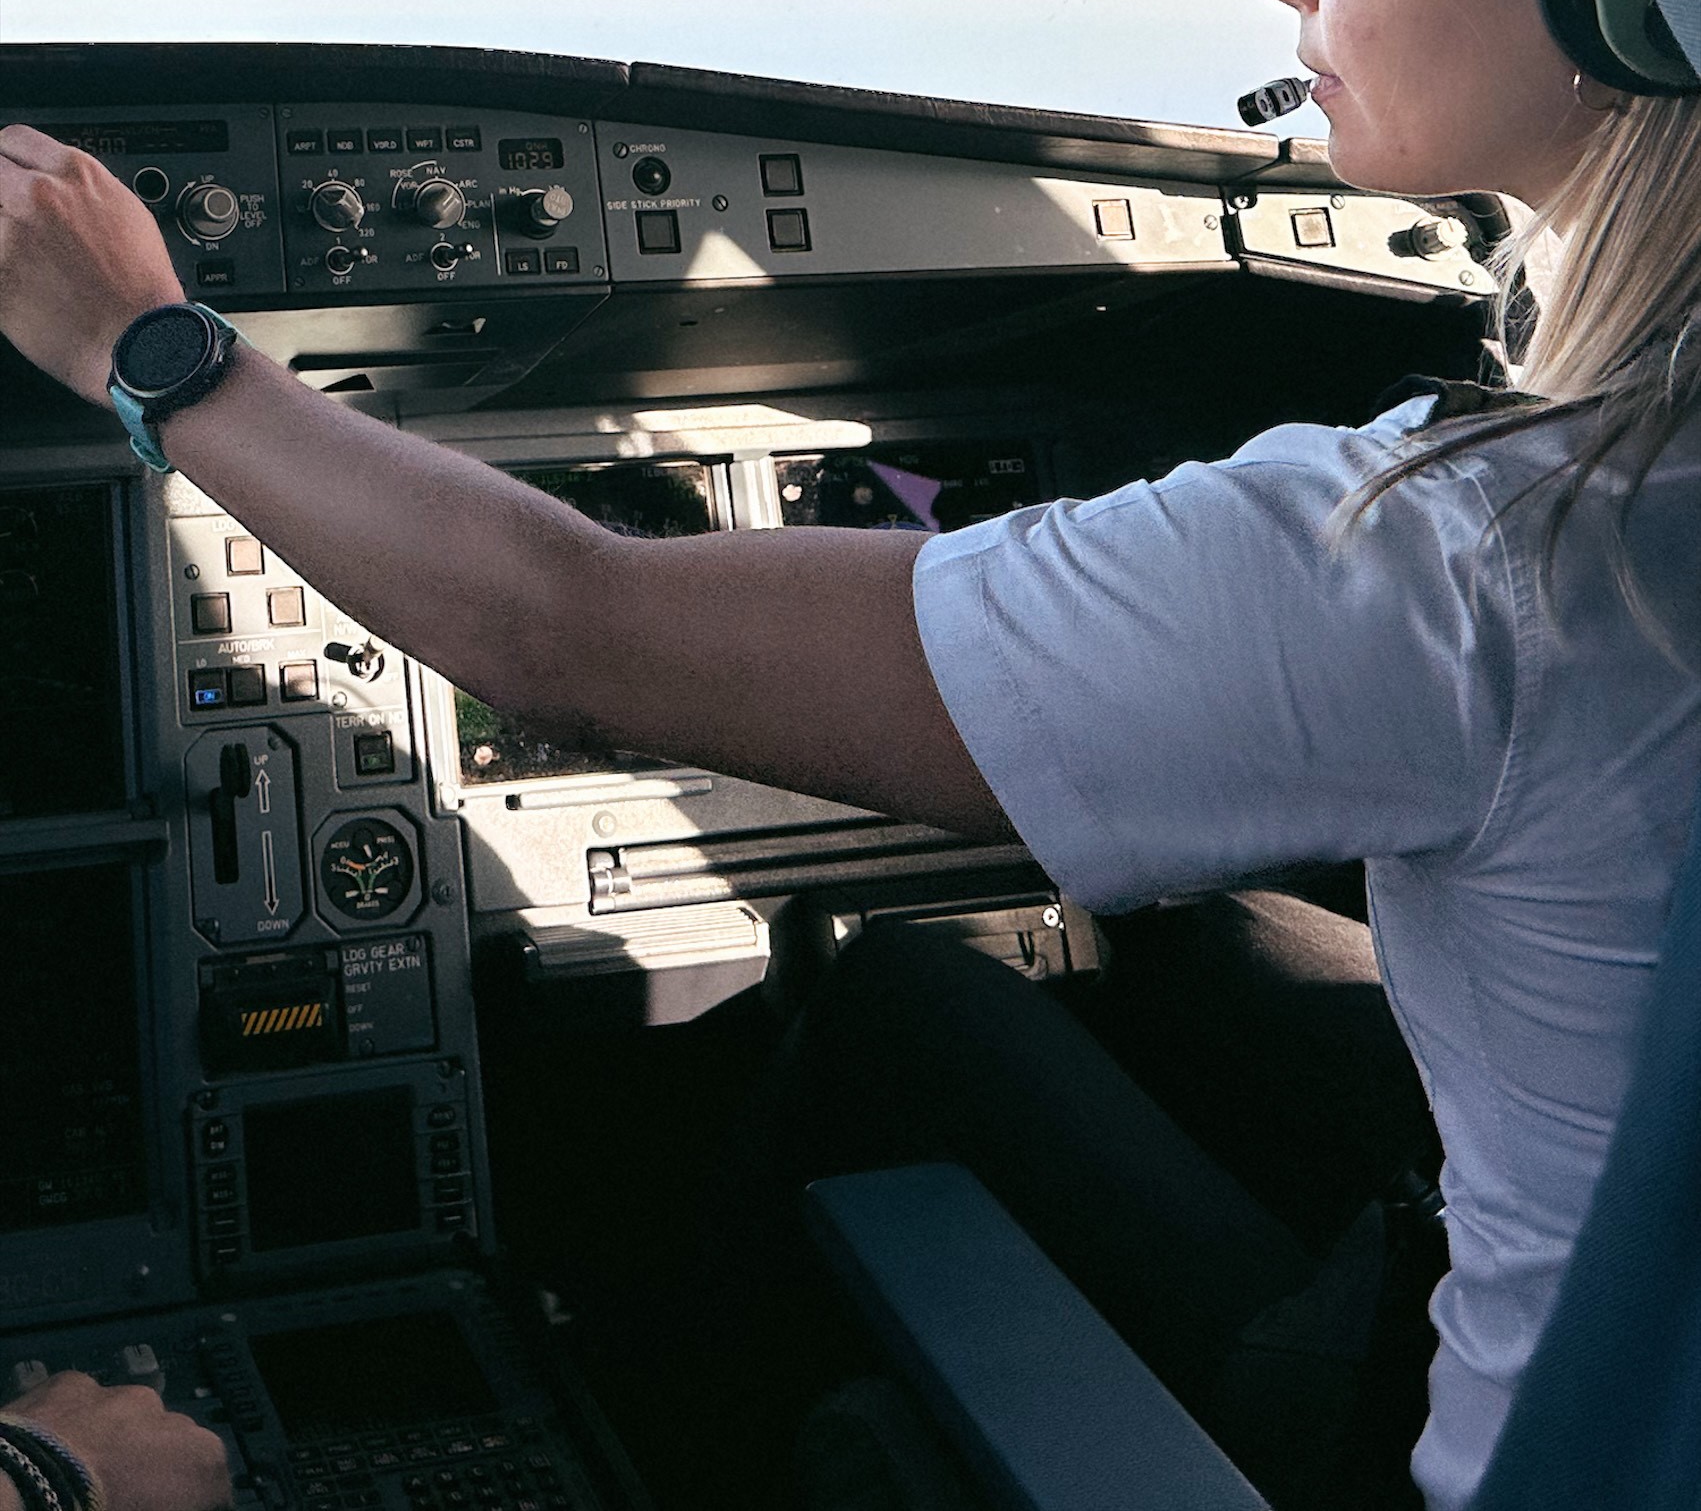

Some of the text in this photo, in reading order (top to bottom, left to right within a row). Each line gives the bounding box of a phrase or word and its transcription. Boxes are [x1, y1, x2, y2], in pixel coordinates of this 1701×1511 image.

[294, 141, 316, 150] ARPT
[336, 140, 354, 150] NDB
[415, 139, 433, 148] WPT
[453, 138, 475, 148] CSTR
[629, 143, 666, 153] CHRONO
[507, 151, 555, 170] 1029
[327, 169, 339, 178] 40
[389, 169, 414, 178] ROSE
[426, 166, 447, 175] NAV
[201, 174, 214, 184] UP
[301, 179, 313, 189] 20
[354, 178, 365, 188] 80
[459, 179, 478, 189] ARC
[239, 194, 265, 204] PUSH
[466, 199, 492, 208] PLAN
[606, 198, 701, 211] SIDE STICK PRIORITY
[239, 210, 267, 220] LEVEL
[244, 219, 262, 228] OFF
[358, 228, 375, 237] 320
[205, 242, 219, 251] DN
[300, 257, 320, 266] ADF
[405, 252, 424, 263] ADF
[517, 262, 529, 271] LS
[556, 260, 568, 270] FD
[204, 273, 228, 283] APPR
[332, 275, 352, 285] OFF
[437, 271, 456, 281] OFF
[335, 715, 365, 728] TERR
[368, 713, 385, 726] ON
[253, 754, 269, 767] UP
[257, 918, 291, 933] DOWN
[342, 942, 405, 963] LDG GEAR
[344, 955, 421, 977] GRVTY EXTN
